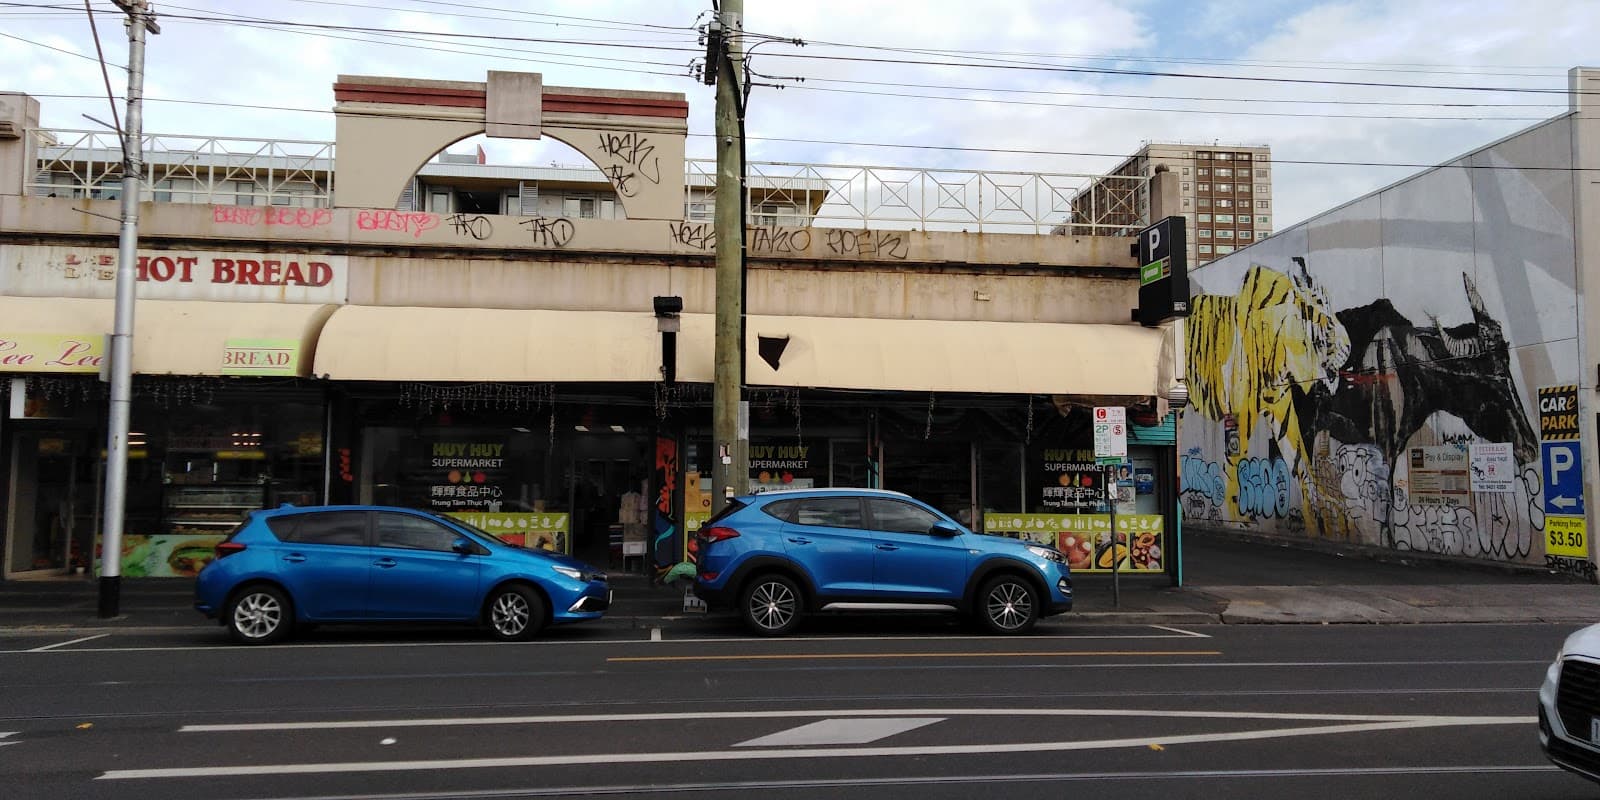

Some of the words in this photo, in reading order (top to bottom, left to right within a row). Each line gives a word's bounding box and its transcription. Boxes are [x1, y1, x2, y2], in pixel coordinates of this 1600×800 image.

[1148, 227, 1161, 262] P
[211, 258, 333, 288] BREAD
[1541, 414, 1578, 430] PARK
[432, 443, 466, 457] HUY
[470, 443, 503, 457] HUY
[778, 446, 808, 459] HUY
[1044, 449, 1074, 462] HUY
[1077, 449, 1095, 462] HU
[431, 458, 503, 468] SUPERMARKET
[749, 460, 808, 469] UPERMARKET
[1550, 446, 1574, 486] P
[431, 500, 451, 508] Trung
[1549, 520, 1569, 529] Parking
[1549, 530, 1583, 548] $3.50
